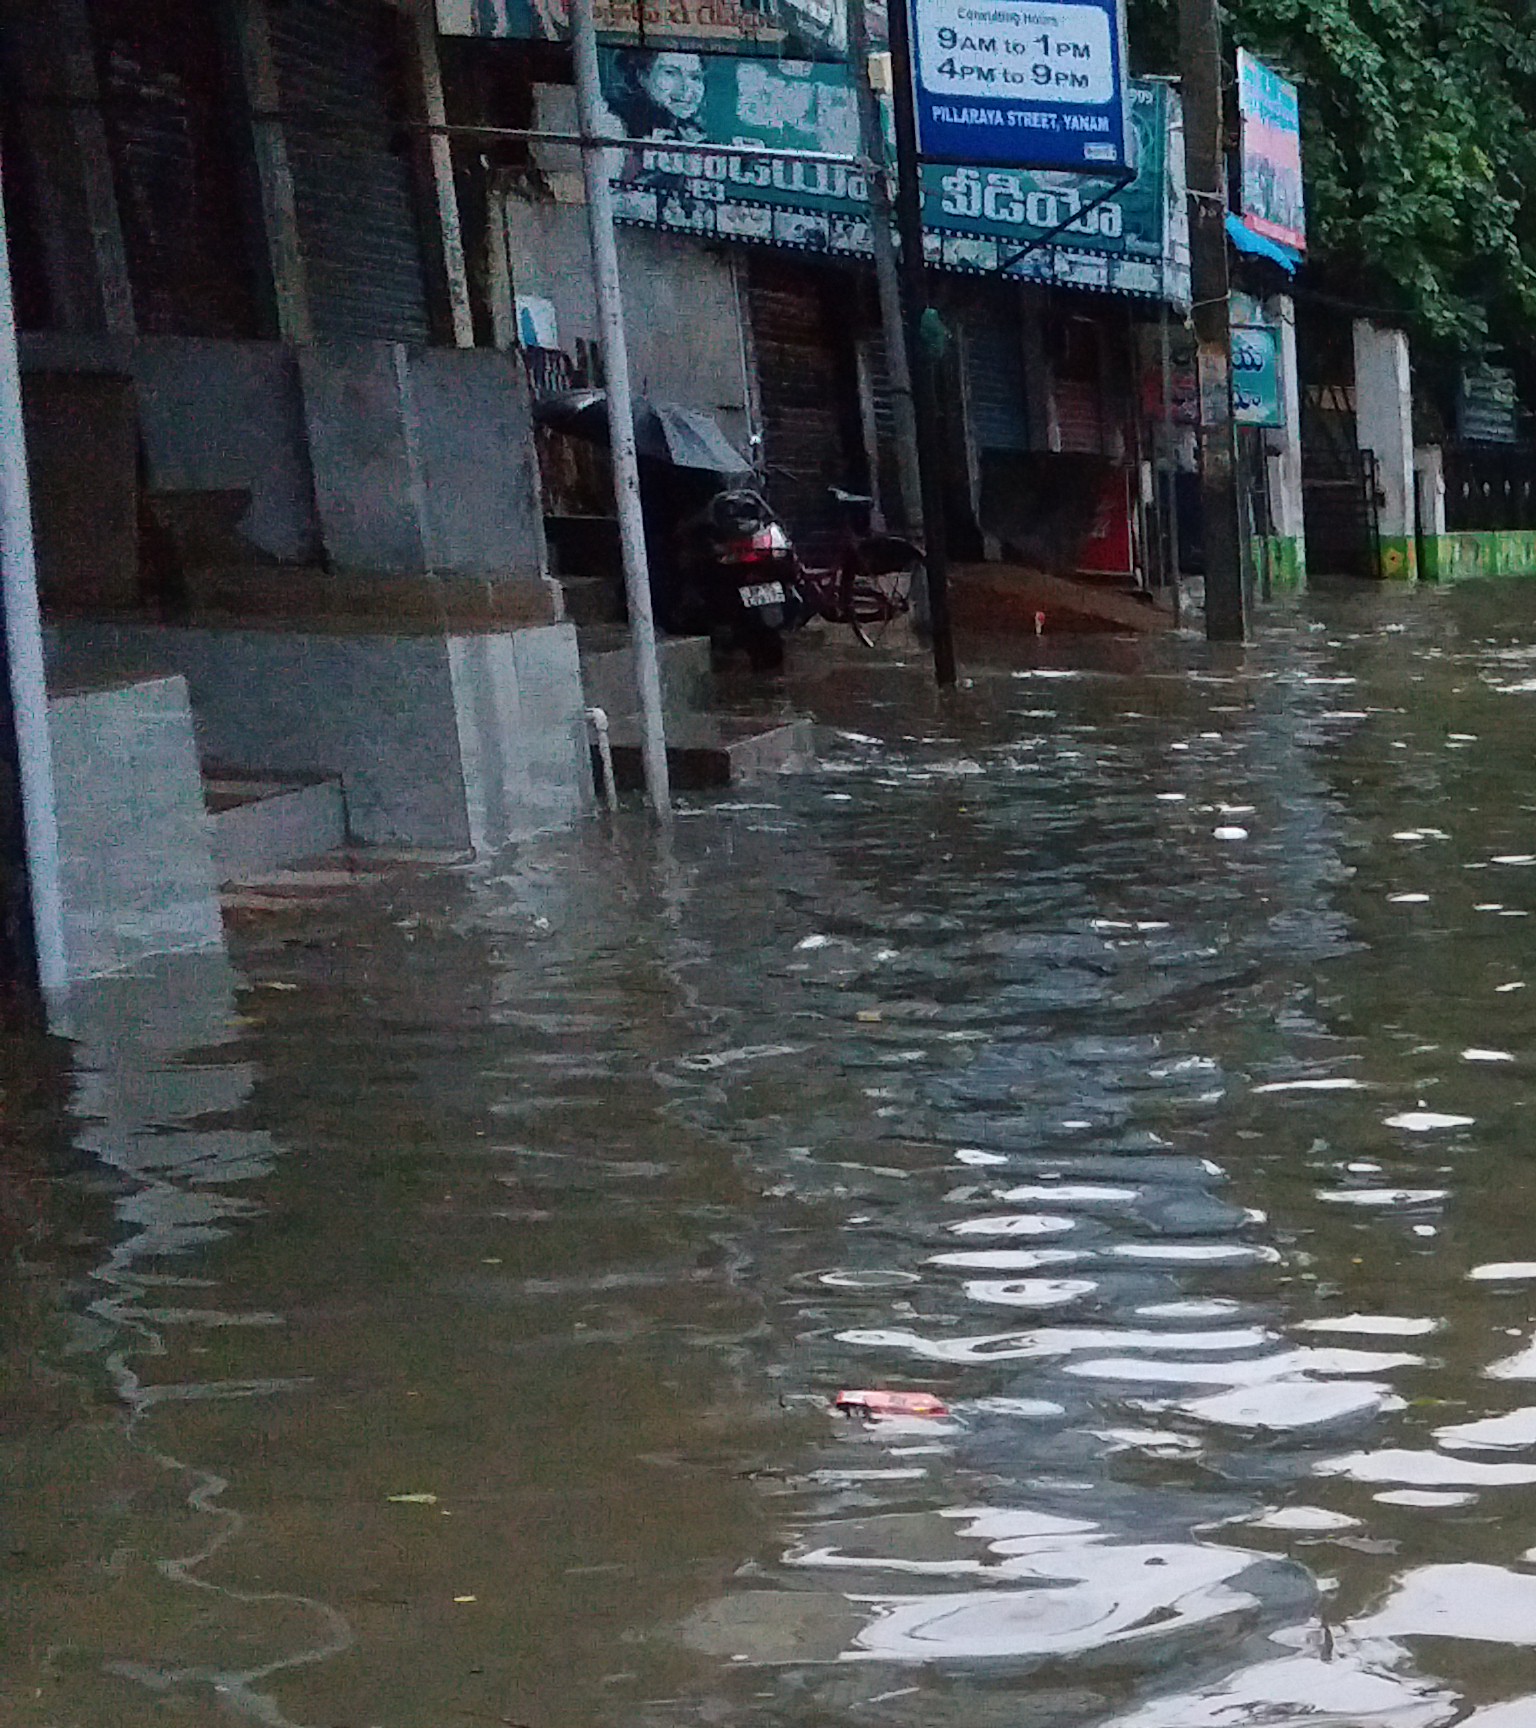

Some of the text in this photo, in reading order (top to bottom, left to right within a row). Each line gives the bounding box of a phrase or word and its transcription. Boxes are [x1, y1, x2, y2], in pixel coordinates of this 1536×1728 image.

[1004, 39, 1026, 55] to
[1004, 67, 1025, 84] to
[932, 105, 1110, 132] PILLARAYA STREET, YANAM
